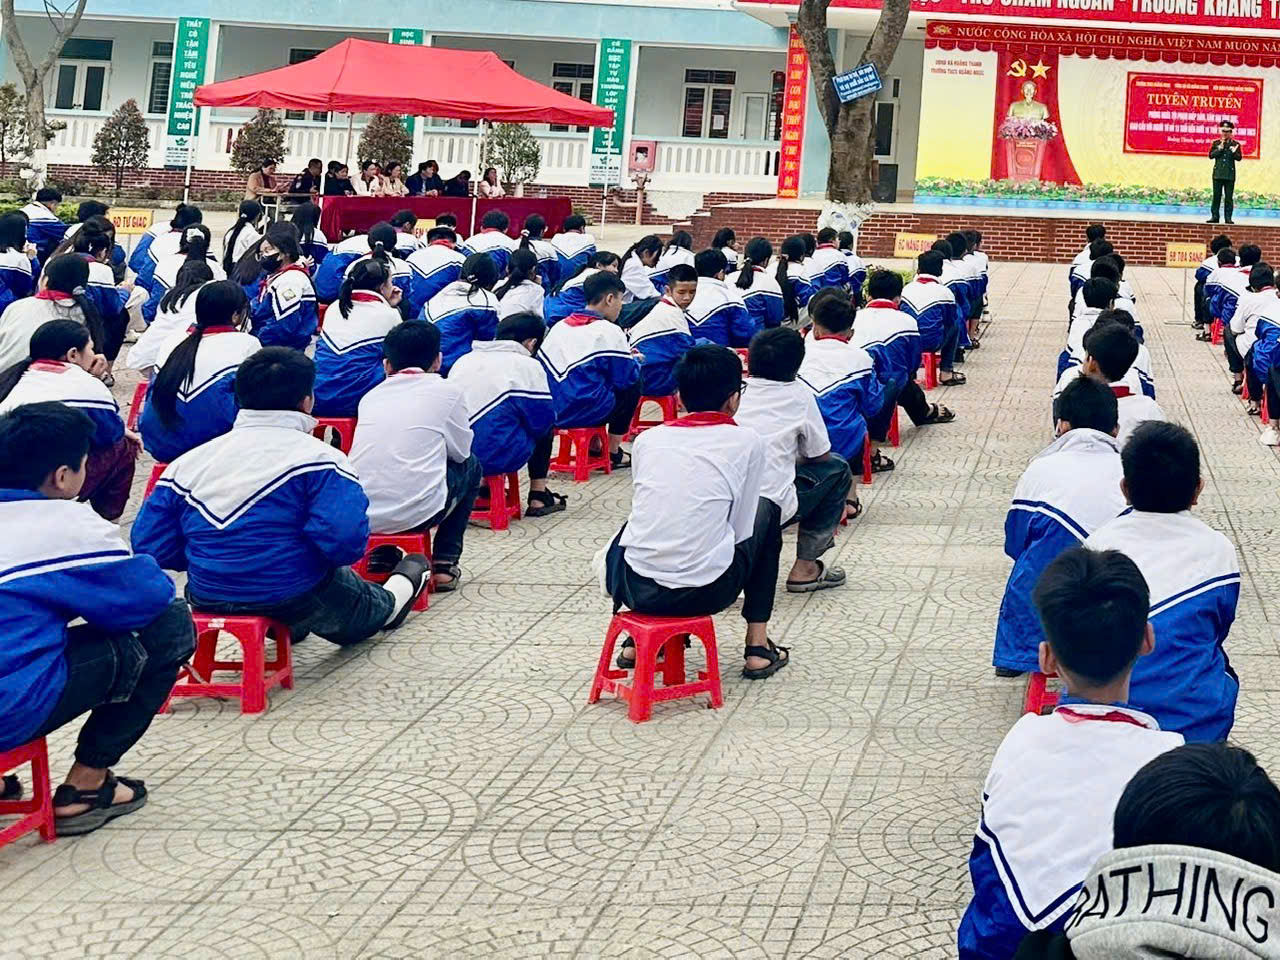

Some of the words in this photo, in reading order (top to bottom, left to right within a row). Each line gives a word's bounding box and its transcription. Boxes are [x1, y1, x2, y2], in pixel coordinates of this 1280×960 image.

[957, 25, 991, 38] NƯỚC
[994, 26, 1027, 41] CỘNG
[1030, 29, 1054, 41] HÒA
[1058, 30, 1072, 42] XÃ
[1076, 31, 1097, 44] HỘI
[1127, 33, 1164, 46] NGHĨA
[1167, 35, 1195, 49] VIỆT
[1197, 39, 1222, 49] NAM
[1225, 38, 1260, 51] MUÔN
[1147, 92, 1188, 105] TUYÊN
[1192, 93, 1242, 109] TRUYỀN
